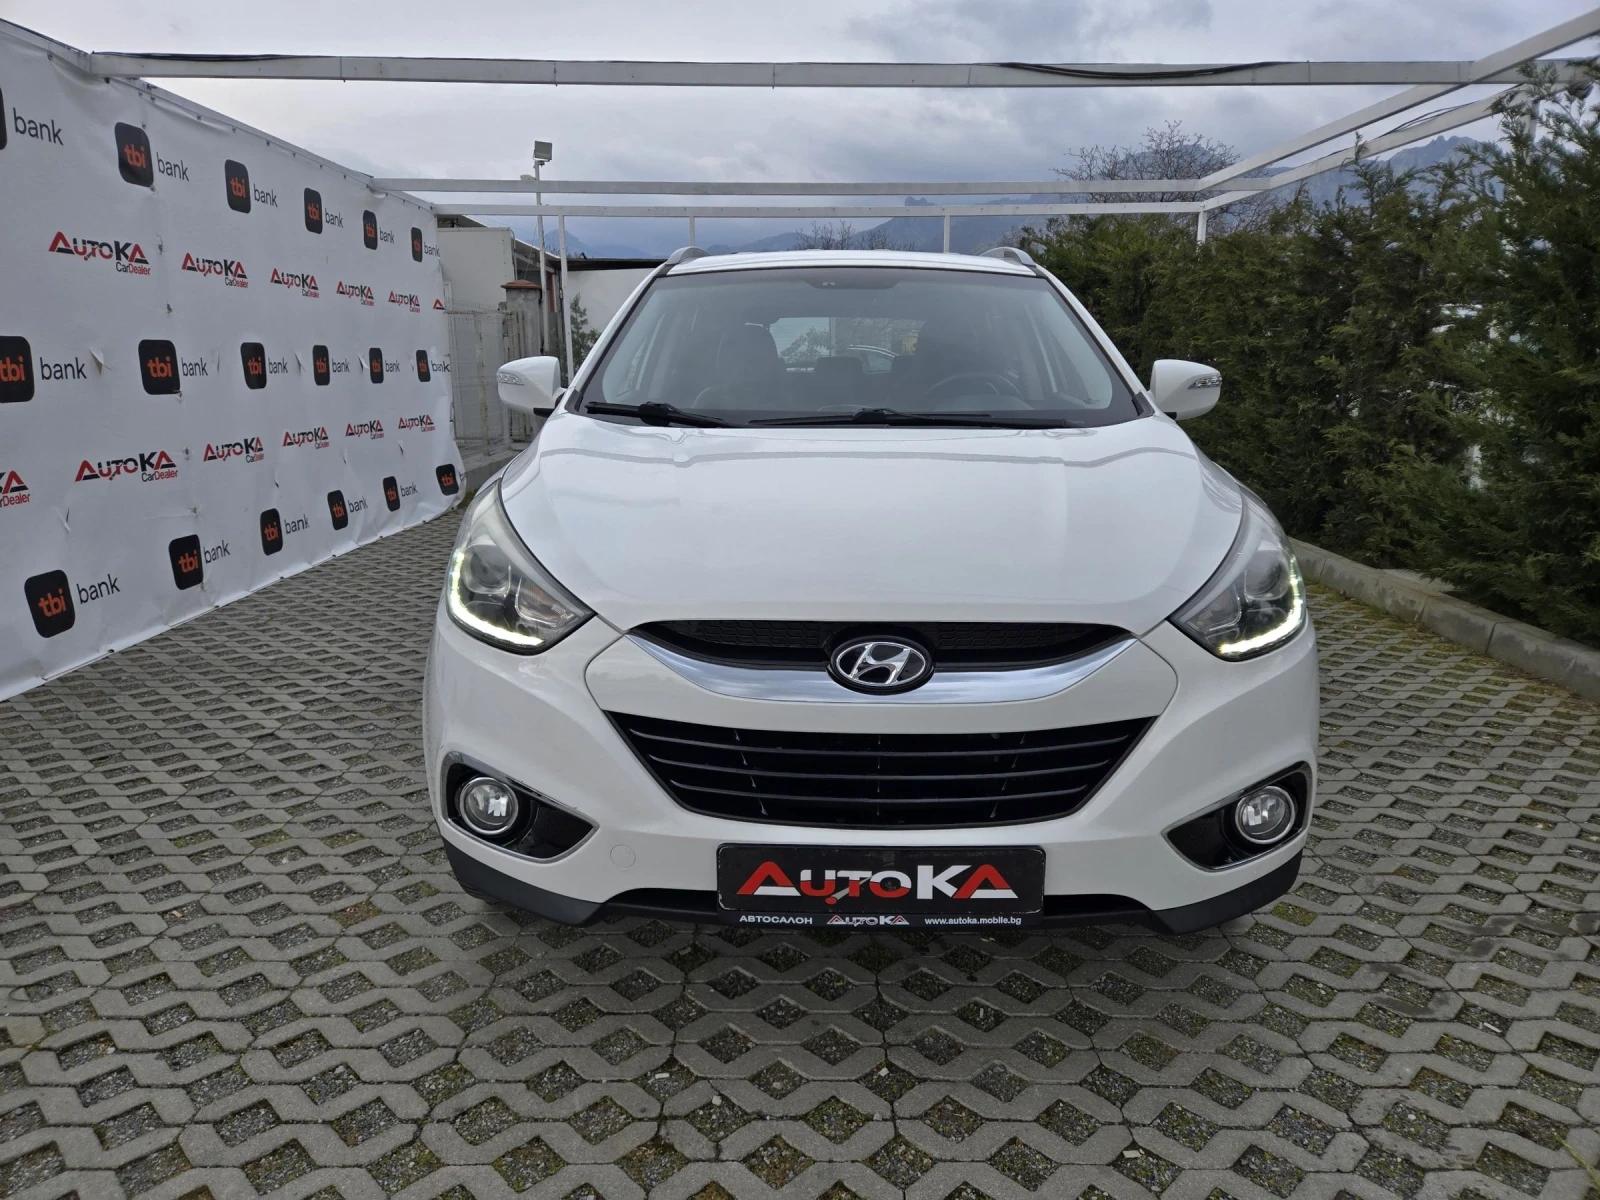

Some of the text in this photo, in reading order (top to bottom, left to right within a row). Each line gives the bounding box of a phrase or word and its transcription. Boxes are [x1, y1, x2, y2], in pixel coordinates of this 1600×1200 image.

[13, 107, 64, 146] bank
[124, 144, 190, 182] tbi bank
[230, 177, 278, 207] tbi bank
[307, 201, 343, 228] tbi bank
[380, 227, 395, 244] bank
[424, 241, 440, 257] bank
[115, 262, 150, 275] CarDealer
[0, 356, 87, 381] tbi bank
[147, 356, 208, 378] tbi bank
[248, 356, 288, 374] tbi bank
[316, 357, 350, 373] tbi bank
[385, 360, 400, 372] bank
[141, 469, 178, 482] CarDealer
[441, 472, 455, 486] tbi
[400, 482, 418, 497] bank
[332, 496, 368, 518] tbi bank
[264, 514, 309, 541] tbi bank
[178, 540, 231, 573] tbi bank
[38, 574, 120, 617] tbi bank
[739, 915, 813, 925] АВТОСАЛОН
[924, 916, 1022, 926] www.autoka.mobile.bg
